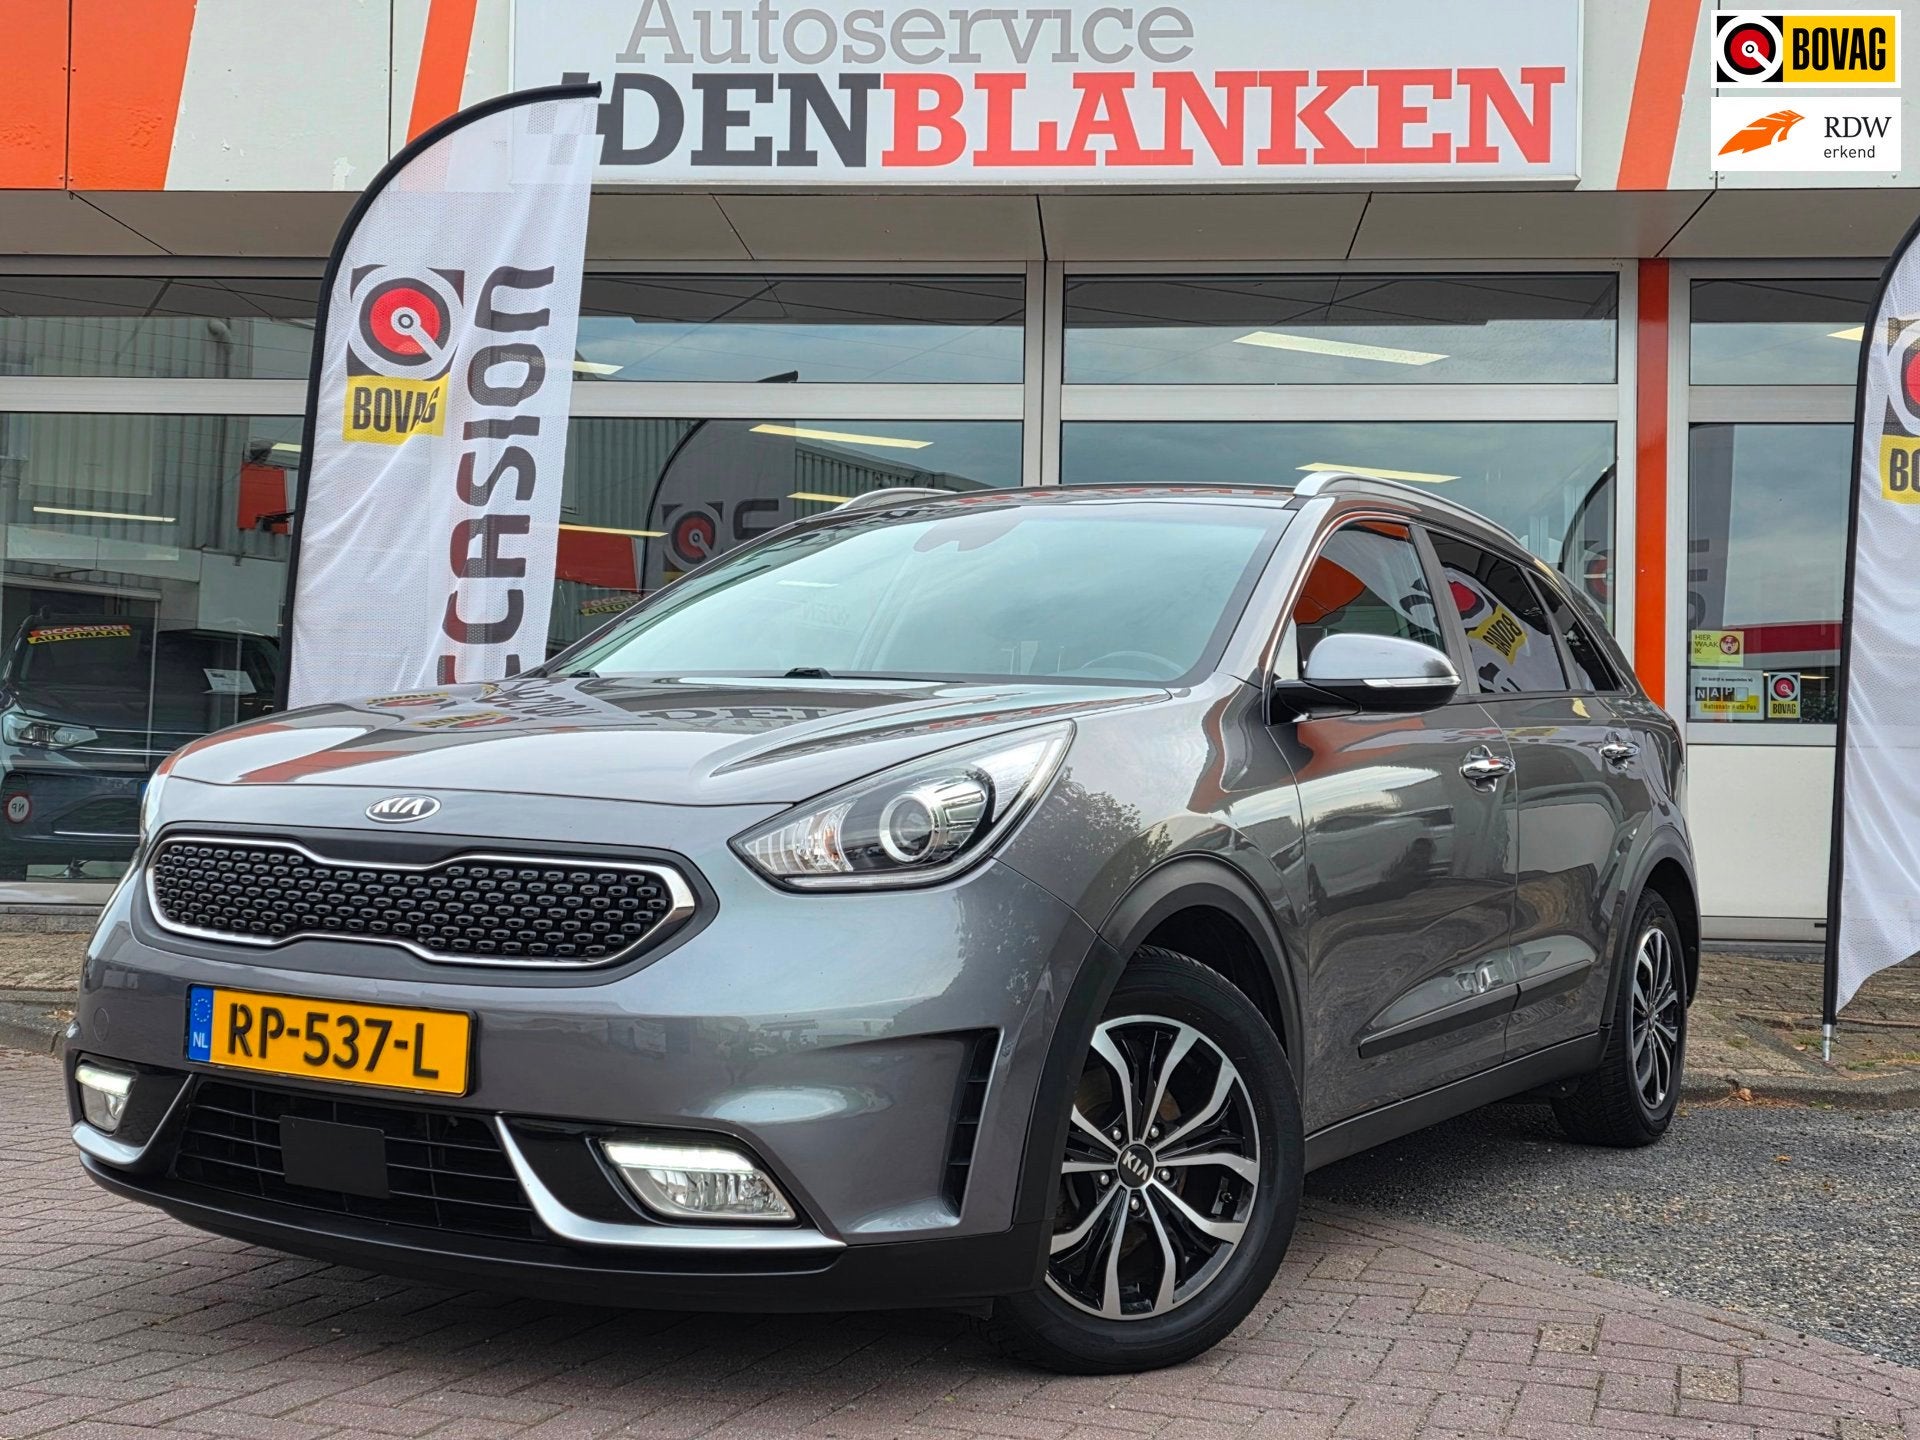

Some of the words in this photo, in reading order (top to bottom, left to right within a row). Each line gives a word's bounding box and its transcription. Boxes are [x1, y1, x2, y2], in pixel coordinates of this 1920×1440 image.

[616, 0, 1194, 64] Autoservice
[351, 385, 440, 434] BOVAG
[35, 630, 126, 642] AUTOMAAT
[40, 624, 127, 636] OCCASION
[1696, 687, 1733, 699] NAP
[1772, 703, 1797, 714] BOVAG
[373, 797, 425, 815] KIA
[192, 1031, 209, 1049] NL
[228, 1003, 439, 1079] RP-537-L
[1122, 1151, 1149, 1181] KIA
